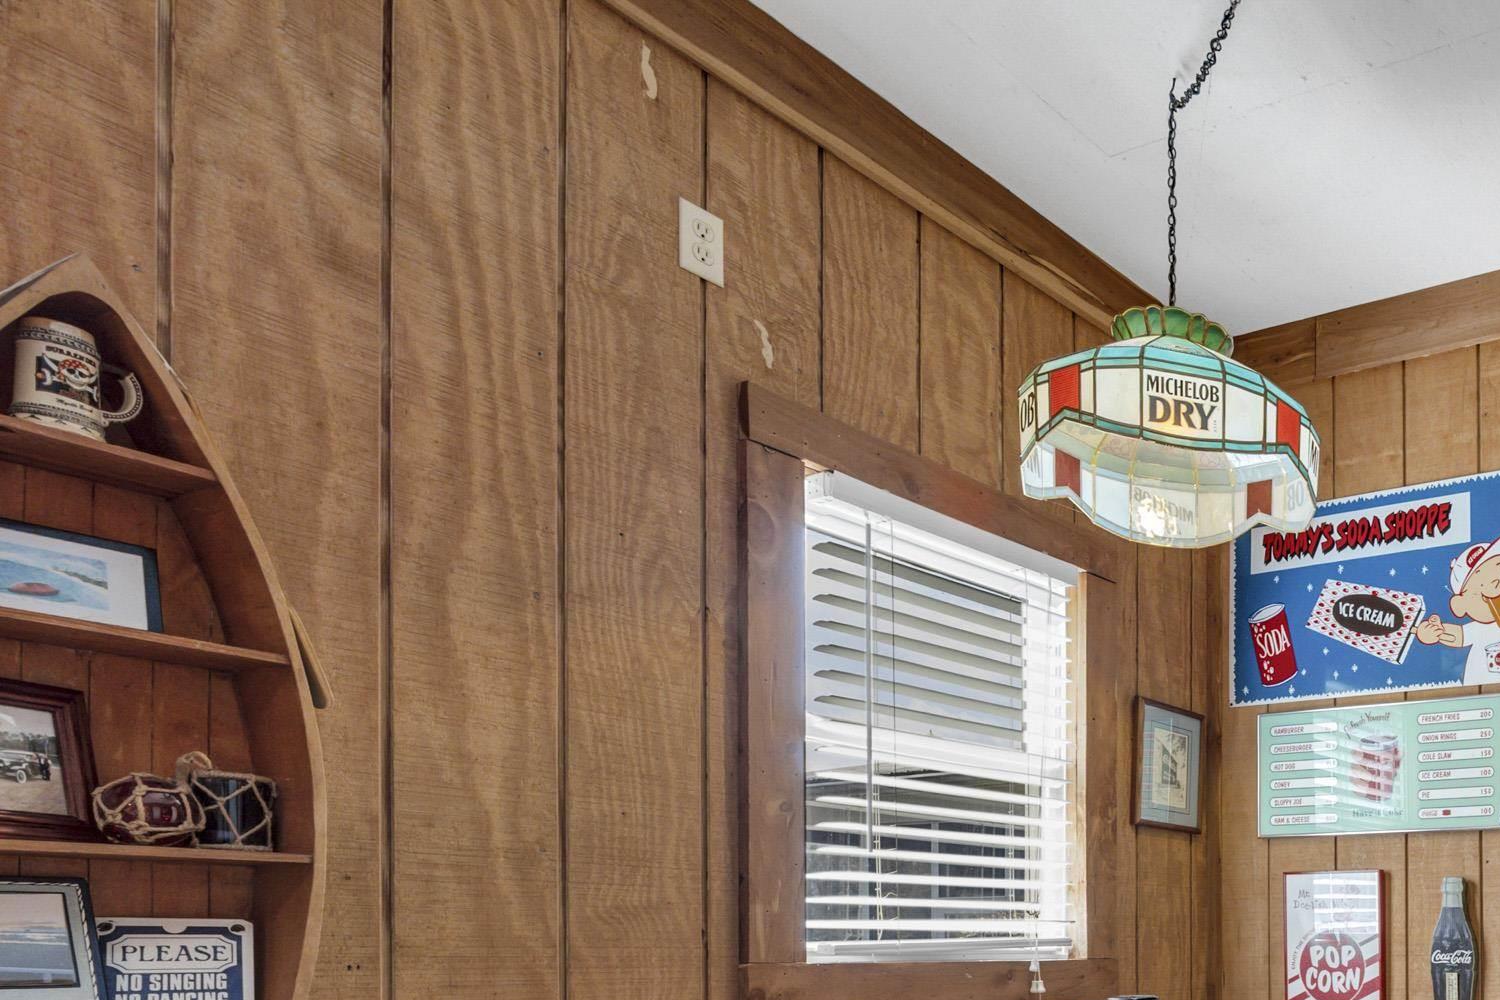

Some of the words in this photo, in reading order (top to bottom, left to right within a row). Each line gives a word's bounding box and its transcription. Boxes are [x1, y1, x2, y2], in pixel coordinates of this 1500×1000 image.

[1146, 374, 1219, 402] MICHELOB
[1148, 395, 1217, 431] DRY
[1262, 521, 1333, 565] TOMMY'S
[1333, 516, 1384, 551] SODA
[1383, 502, 1452, 540] SHOPPE
[1338, 601, 1354, 618] ICE
[1355, 604, 1395, 628] CREAM
[1255, 625, 1291, 659] SODA
[1444, 713, 1460, 721] FRIES
[1274, 726, 1304, 734] HAMBURGER
[1421, 734, 1438, 742] ONION
[1440, 732, 1457, 740] RINGS
[1274, 744, 1312, 753] CHEESEBURGER
[1421, 753, 1435, 761] COLE
[1437, 752, 1452, 760] SLAW
[1274, 762, 1284, 770] HOT
[1432, 771, 1451, 779] CREAM
[1291, 815, 1310, 823] CHEESE
[121, 945, 230, 962] PLEASE
[1308, 945, 1357, 967] POP
[1431, 949, 1473, 964] Coca-Cola
[115, 974, 142, 992] NO
[149, 973, 228, 991] SINGING
[1305, 968, 1360, 994] CORN
